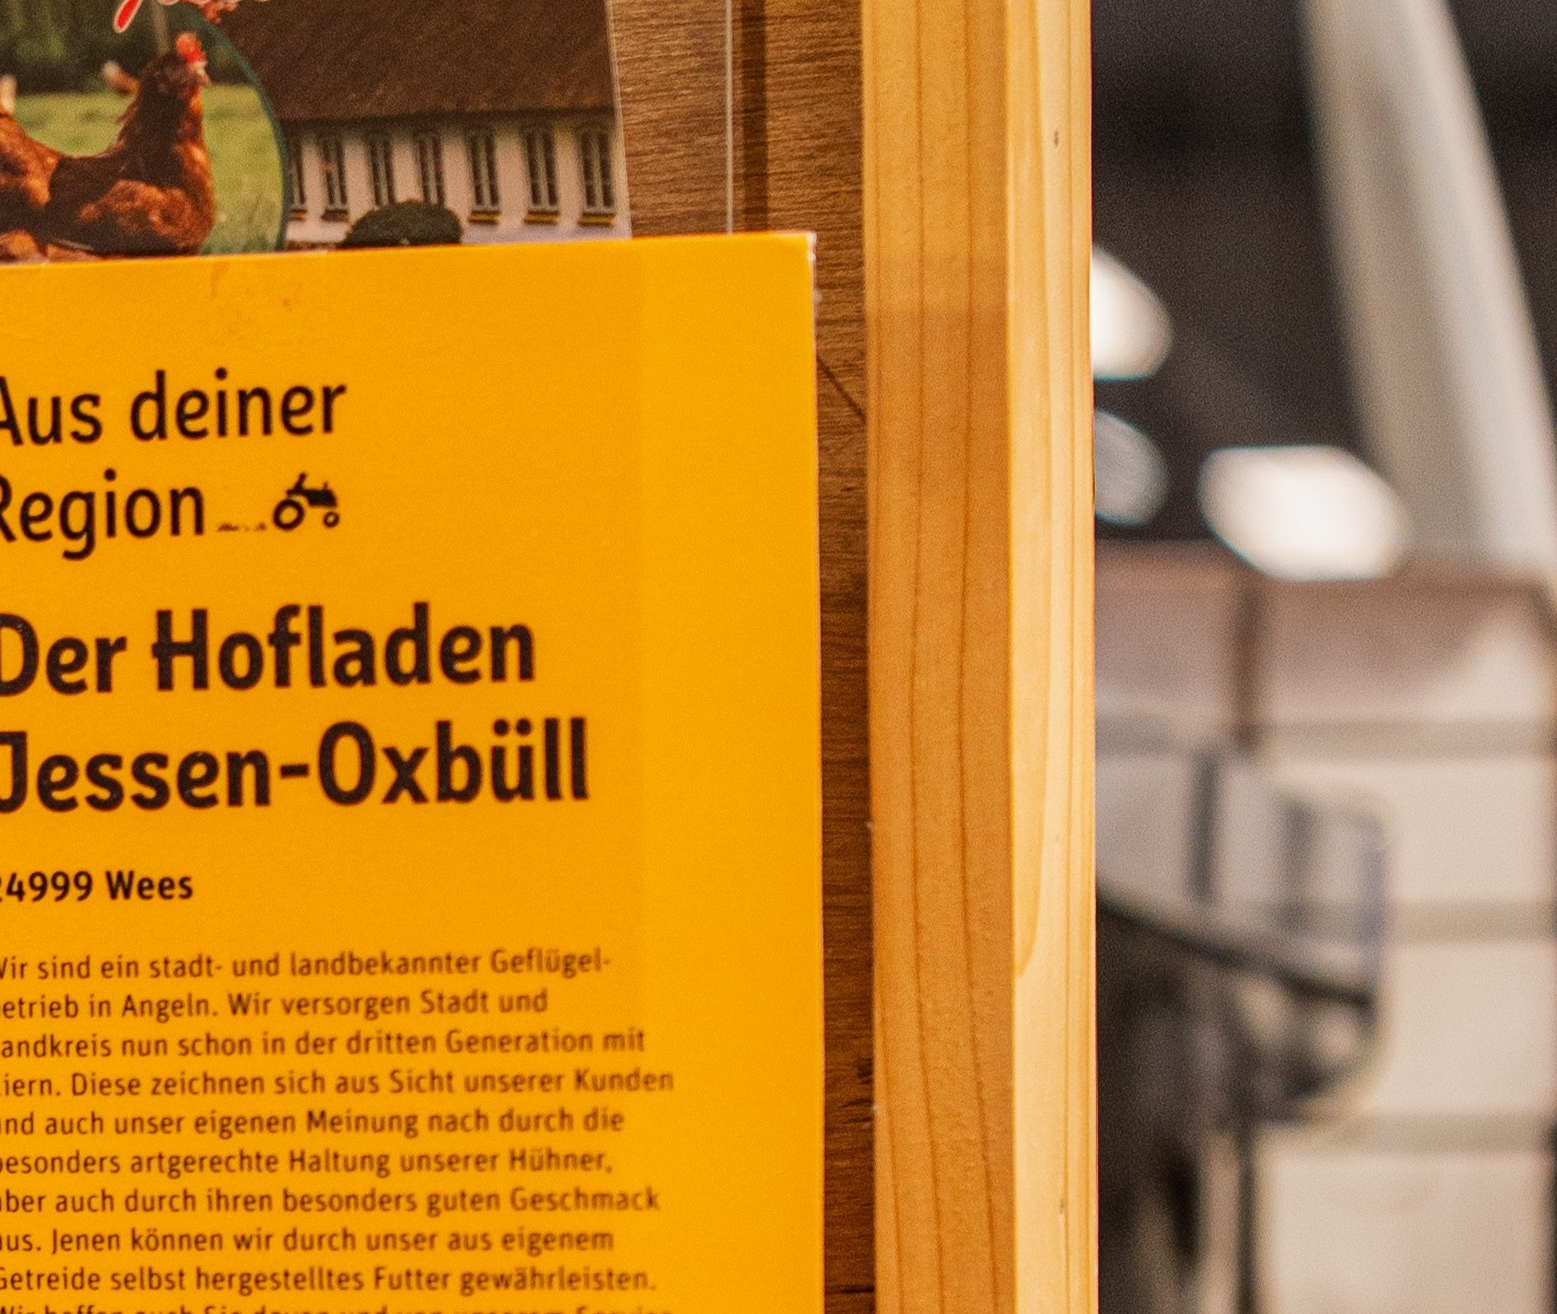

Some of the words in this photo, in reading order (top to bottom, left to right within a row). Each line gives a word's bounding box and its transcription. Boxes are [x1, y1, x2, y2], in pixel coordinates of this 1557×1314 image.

[129, 367, 347, 443] deiner
[151, 601, 536, 692] Hofladen
[106, 870, 194, 901] Wees
[37, 954, 91, 980] sind
[100, 954, 140, 979] ein
[149, 953, 222, 979] stadt-
[232, 952, 280, 978] und
[290, 951, 481, 977] landbekannter
[489, 947, 611, 980] Geflügel-
[88, 994, 112, 1017] in
[121, 993, 217, 1024] Angeln.
[227, 992, 271, 1016] Wir
[281, 996, 410, 1021] versorgen
[420, 989, 489, 1014] Stadt
[498, 988, 548, 1014] und
[121, 1038, 168, 1057] nun
[177, 1032, 252, 1057] schon
[262, 1032, 286, 1054] in
[294, 1031, 337, 1055] der
[345, 1030, 436, 1055] dritten
[445, 1028, 594, 1054] Generation
[602, 1027, 645, 1052] mit
[71, 1072, 141, 1097] Diese
[150, 1071, 265, 1096] zeichnen
[274, 1070, 326, 1095] sich
[335, 1074, 380, 1094] aus
[389, 1068, 454, 1094] Sicht
[464, 1073, 564, 1093] unserer
[574, 1067, 674, 1093] Kunden
[44, 1110, 104, 1136] auch
[114, 1116, 184, 1135] unser
[193, 1110, 296, 1140] eigenen
[306, 1109, 419, 1139] Meinung
[428, 1108, 489, 1133] nach
[498, 1107, 574, 1133] durch
[583, 1107, 625, 1132] die
[130, 1149, 279, 1180] artgerechte
[289, 1149, 391, 1179] Haltung
[400, 1153, 499, 1173] unserer
[54, 1188, 115, 1213] auch
[124, 1188, 196, 1213] durch
[206, 1188, 273, 1213] ihren
[282, 1187, 418, 1213] besonders
[426, 1190, 500, 1218] guten
[509, 1186, 660, 1212] Geschmack
[51, 1228, 121, 1255] Jenen
[130, 1227, 223, 1252] können
[233, 1227, 273, 1251] wir
[282, 1227, 356, 1252] durch
[366, 1232, 437, 1252] unser
[447, 1232, 493, 1252] aus
[500, 1227, 614, 1257] eigenem
[110, 1266, 185, 1291] selbst
[195, 1266, 365, 1297] hergestelltes
[373, 1265, 450, 1291] Futter
[459, 1266, 656, 1297] gewährleisten.
